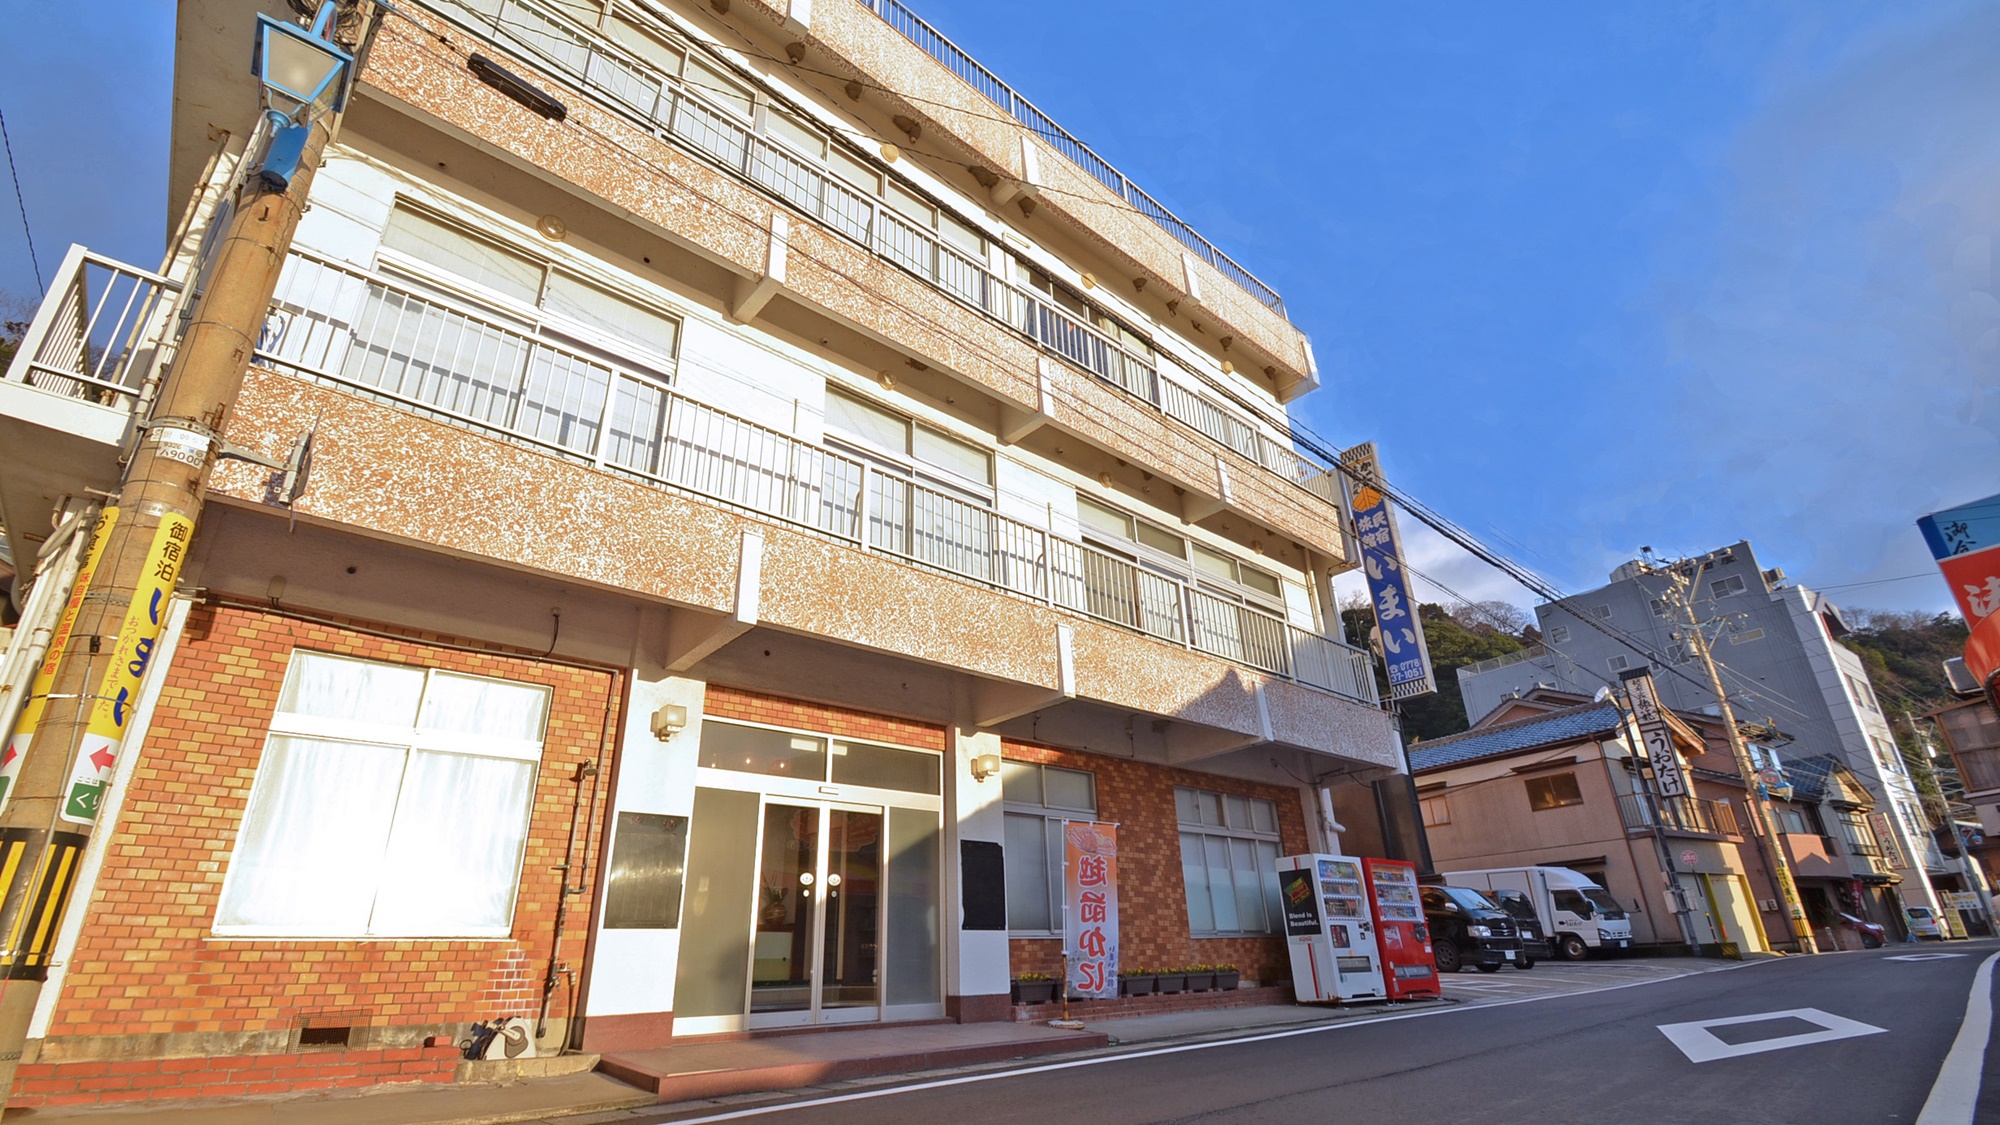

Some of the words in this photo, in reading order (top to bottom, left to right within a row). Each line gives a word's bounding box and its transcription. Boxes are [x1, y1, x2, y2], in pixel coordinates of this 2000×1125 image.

[154, 521, 191, 582] 御宿泊
[43, 572, 91, 676] 味自慢と温泉の宿
[1366, 554, 1416, 655] いまい
[1391, 667, 1423, 683] 37-1051
[1400, 658, 1420, 671] 0778
[1650, 731, 1680, 793] うおたけ
[1290, 919, 1319, 927] Beautiful.
